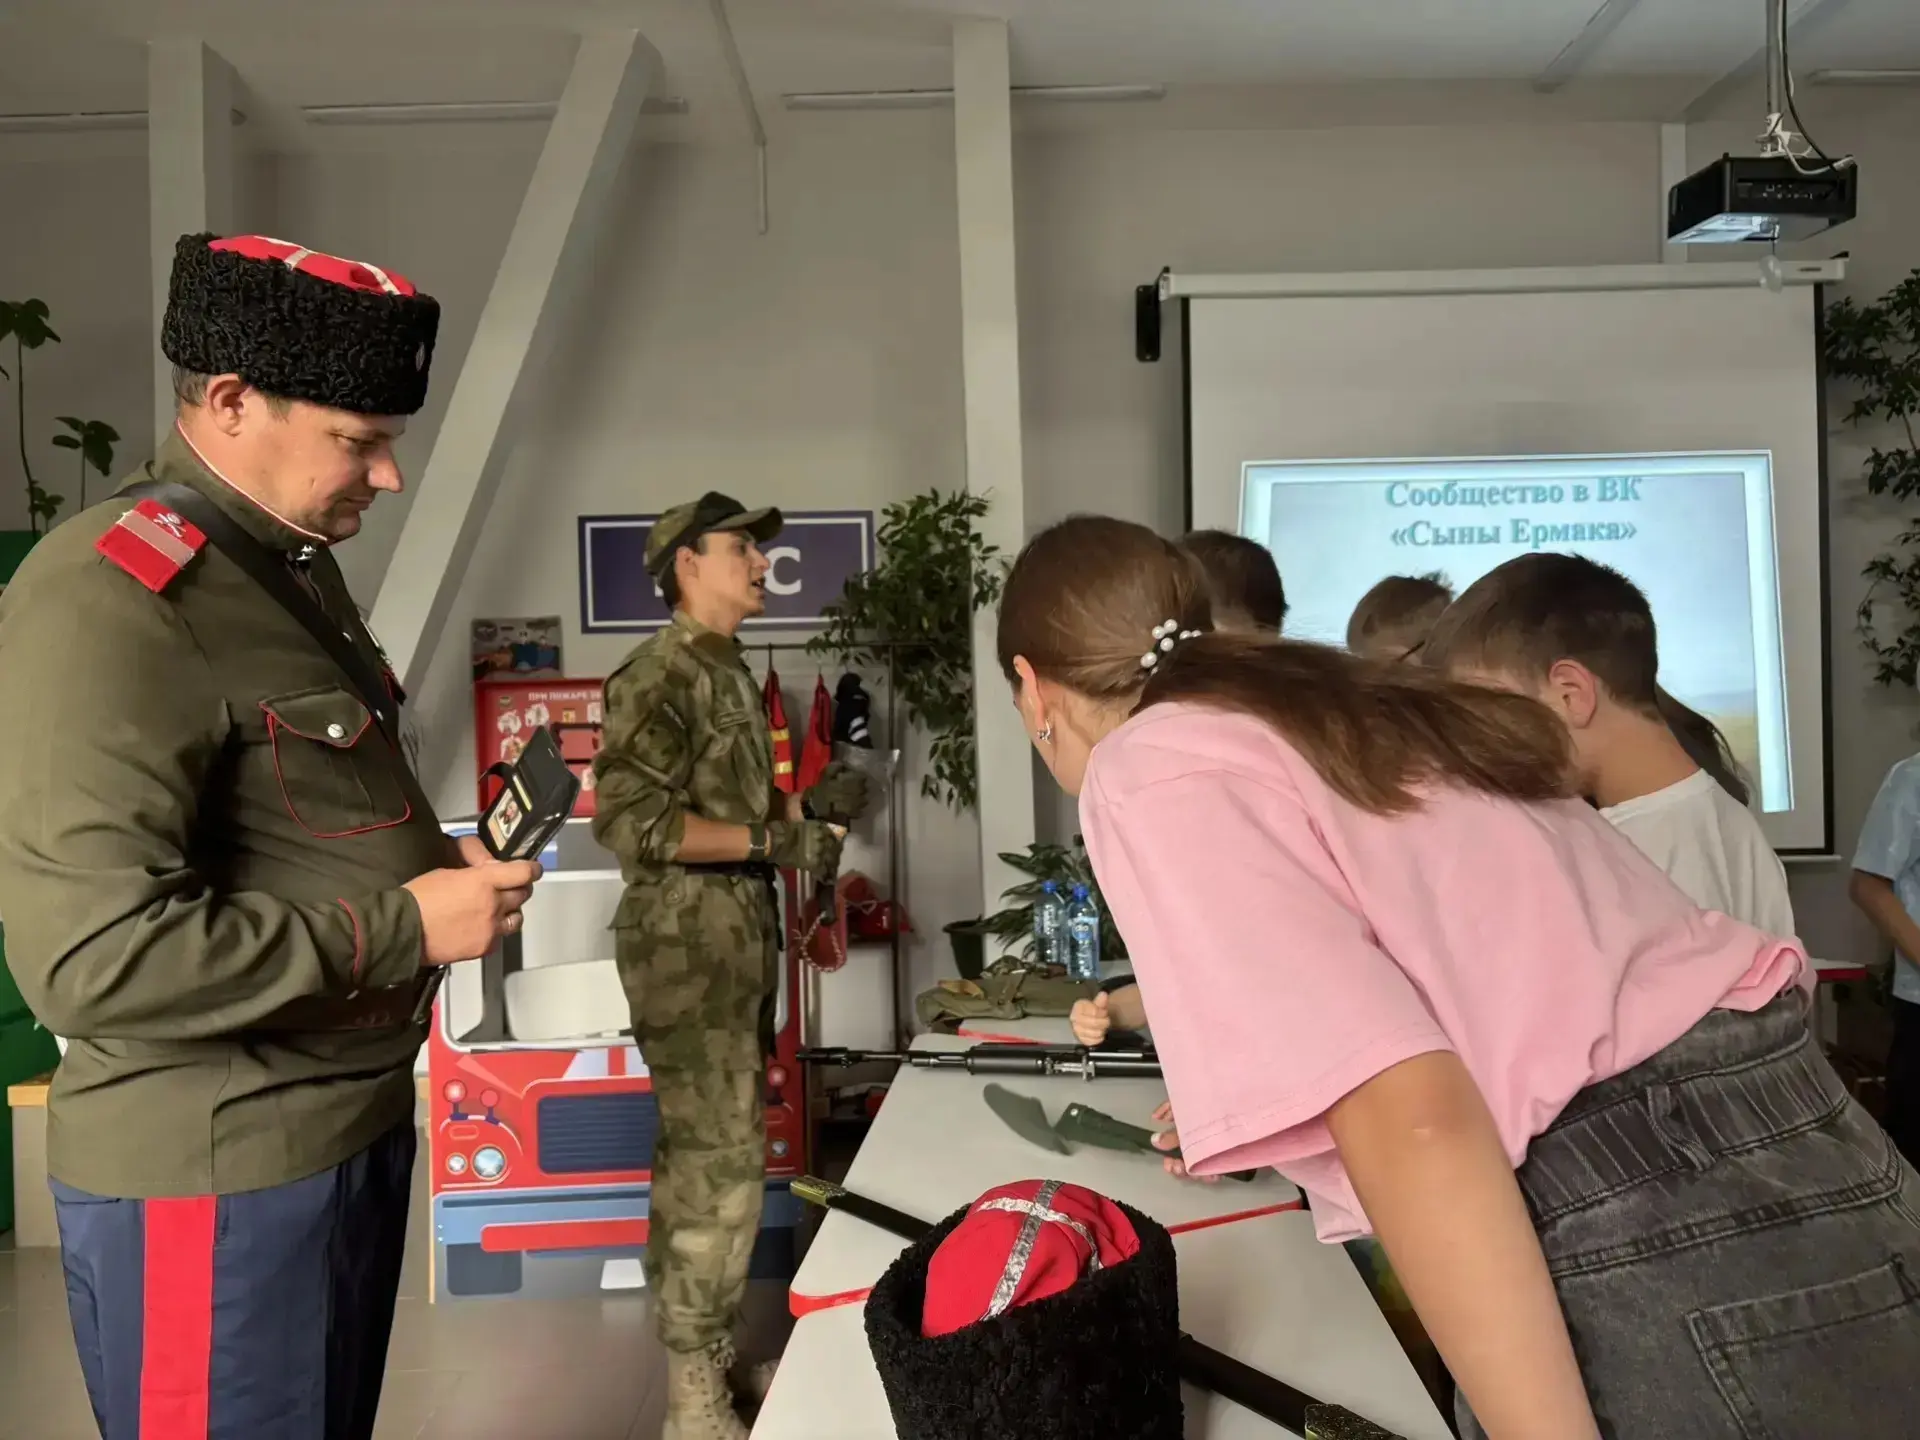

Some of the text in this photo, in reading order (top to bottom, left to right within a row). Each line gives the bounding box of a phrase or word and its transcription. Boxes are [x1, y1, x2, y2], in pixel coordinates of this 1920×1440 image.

[1385, 476, 1642, 508] Сообщество в ВК
[1390, 518, 1638, 549] «Сыны Ермака»
